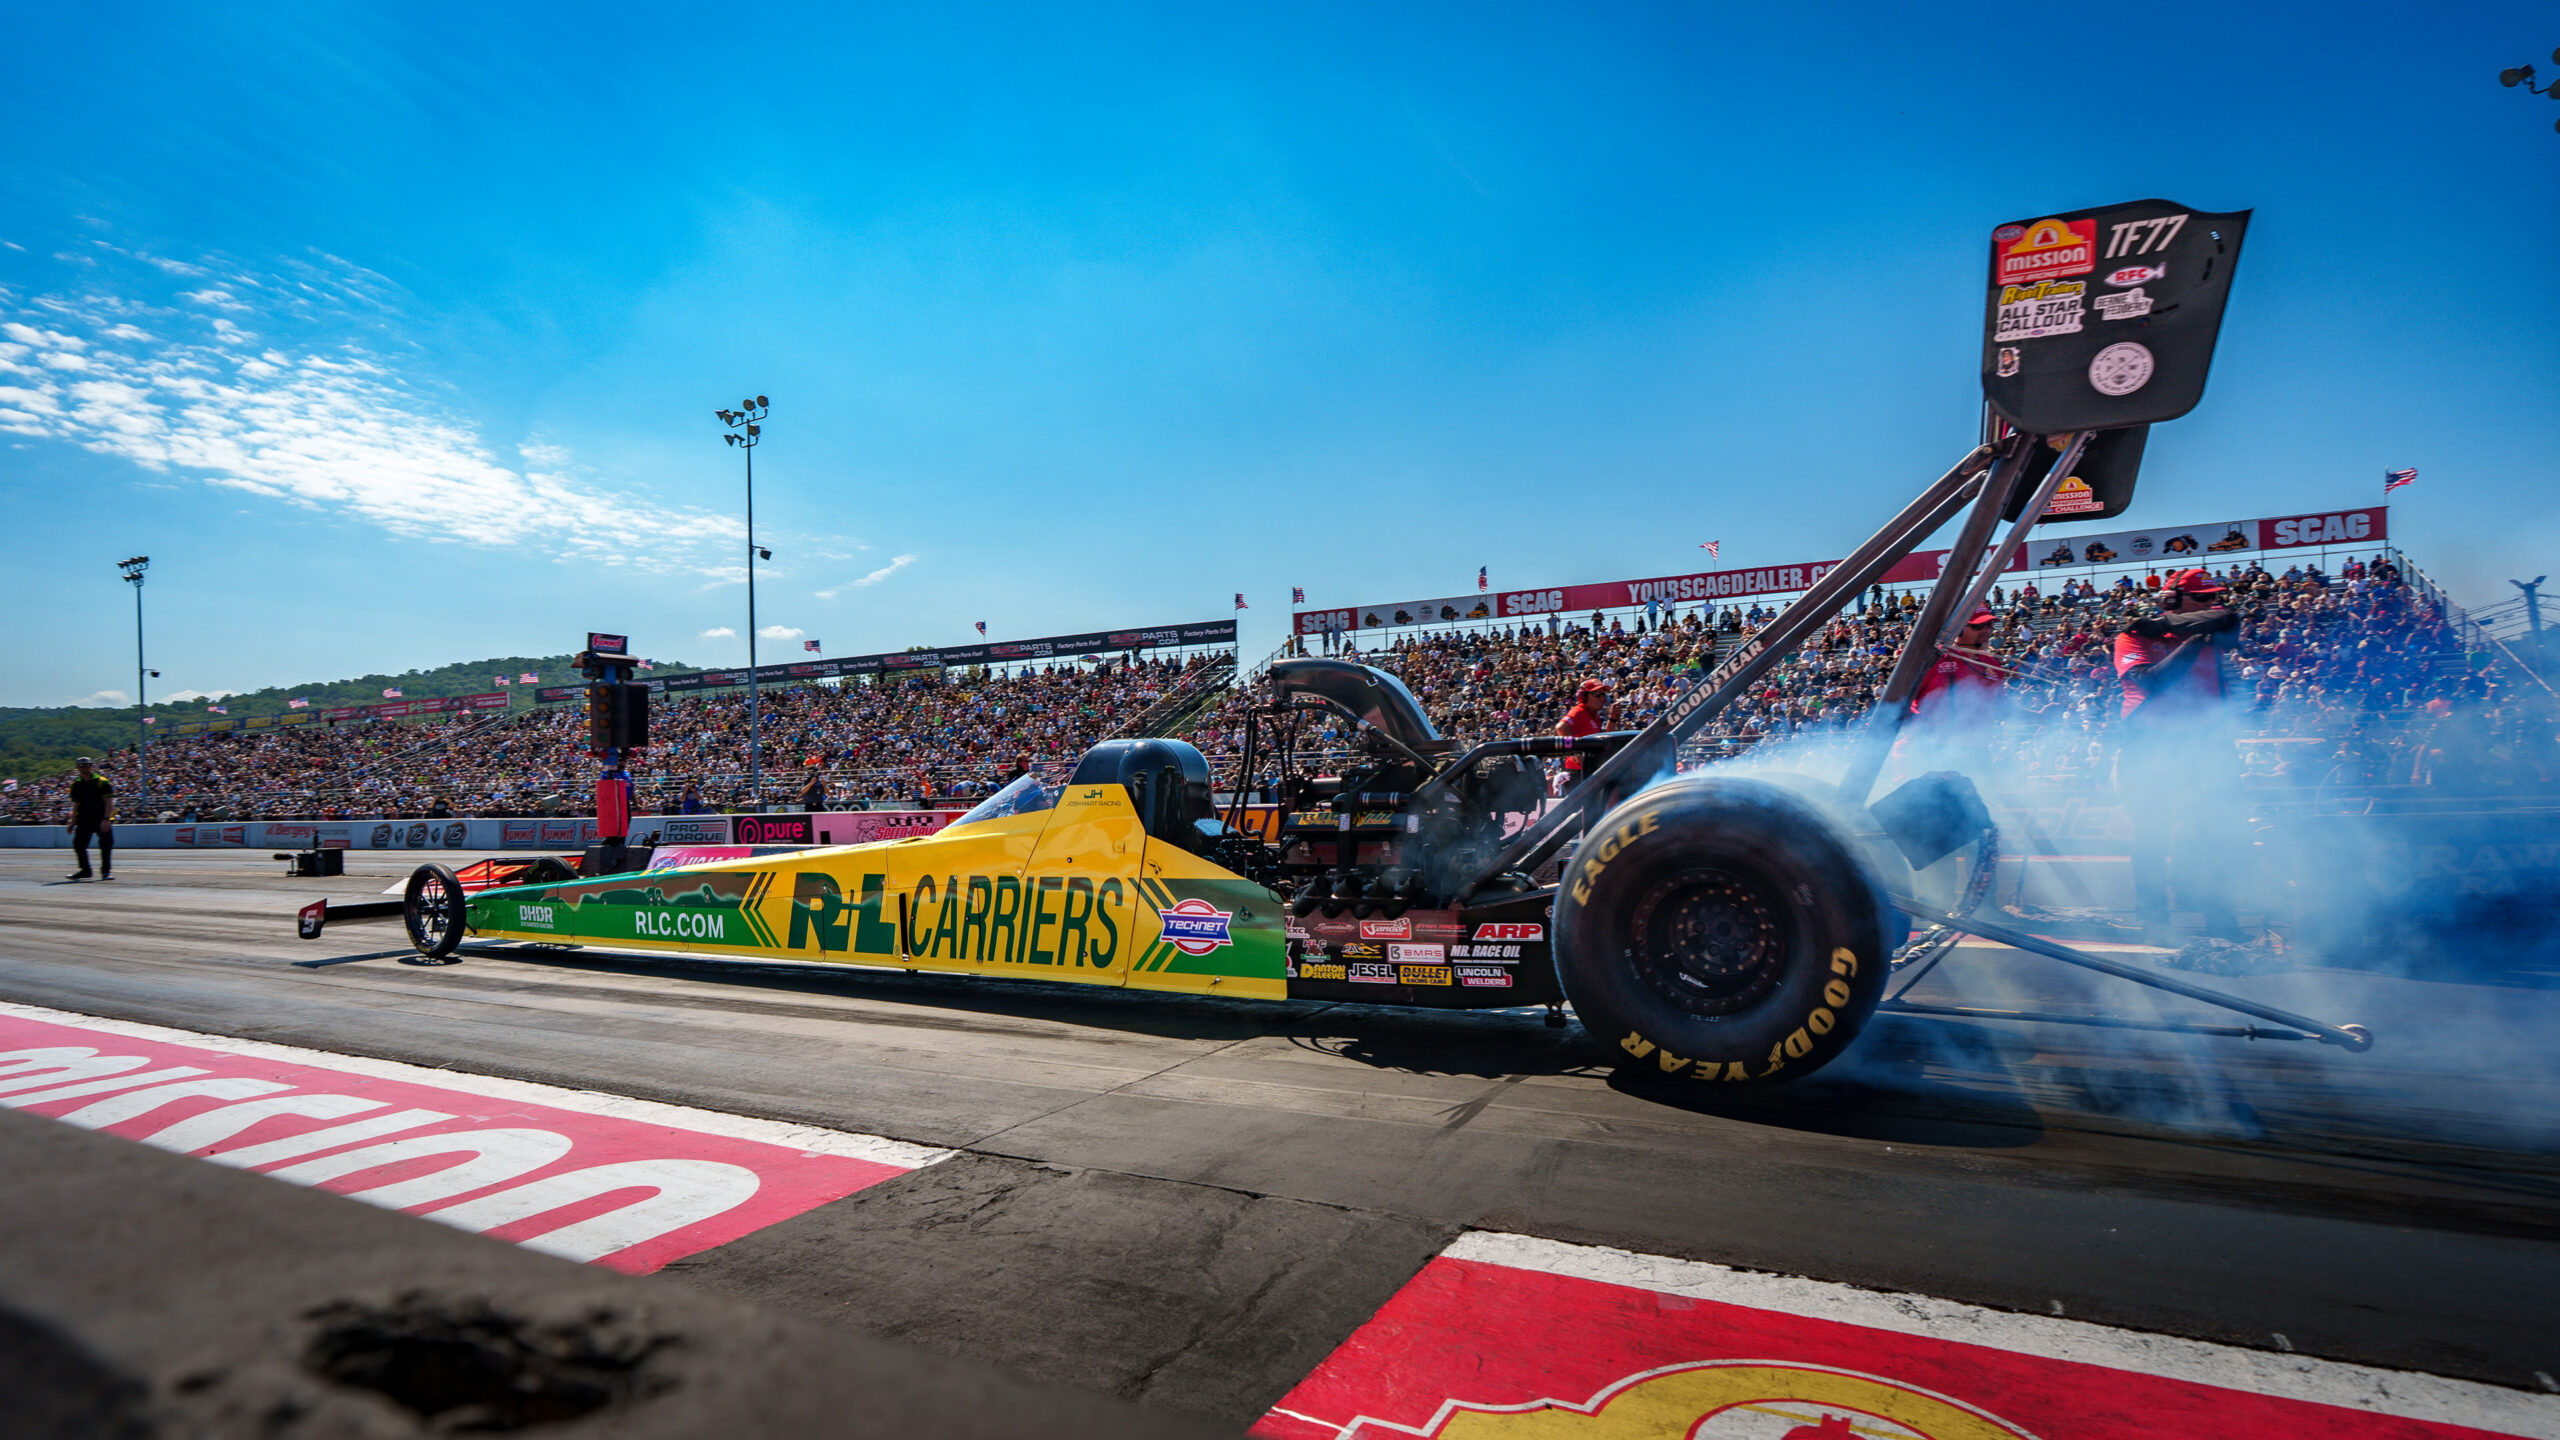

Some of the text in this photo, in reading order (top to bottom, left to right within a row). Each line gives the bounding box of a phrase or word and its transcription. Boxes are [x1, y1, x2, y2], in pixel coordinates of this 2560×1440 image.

[2104, 214, 2190, 259] TF77
[2005, 247, 2086, 273] MISSION
[2115, 267, 2148, 282] RFC
[2001, 299, 2079, 320] ALL STAR
[2000, 311, 2078, 333] CALLOUT
[2053, 490, 2090, 500] MISSION
[2055, 503, 2100, 513] CHALLENGE
[2274, 512, 2371, 546] SCAG
[1627, 564, 1838, 604] YOURSCAGDEALER.C
[1506, 590, 1563, 615] SCAG
[1301, 610, 1350, 634] SCAG
[1205, 628, 1219, 636] Parts
[1156, 638, 1180, 646] .COM
[1032, 649, 1054, 657] .COM
[1666, 640, 1765, 726] GOODYEAR
[1084, 789, 1103, 799] JH
[669, 824, 700, 833] PRO
[763, 821, 805, 844] pure
[665, 832, 724, 841] TORQUE
[1571, 810, 1660, 907] EAGLE
[519, 904, 554, 923] DHDR
[788, 872, 1124, 969] R+L CARRIERS
[302, 909, 318, 934] 5
[635, 911, 724, 939] RLC.COM
[1168, 920, 1225, 932] TECHNET
[1475, 924, 1542, 939] ARP
[1404, 949, 1443, 957] BMRS
[1450, 945, 1521, 958] MR. RACE OIL
[1312, 971, 1347, 980] SLEEVES
[1350, 964, 1396, 978] JESEL
[1402, 967, 1450, 978] BULLET
[1457, 968, 1501, 977] LINCOLN
[1467, 978, 1507, 986] WELDERS
